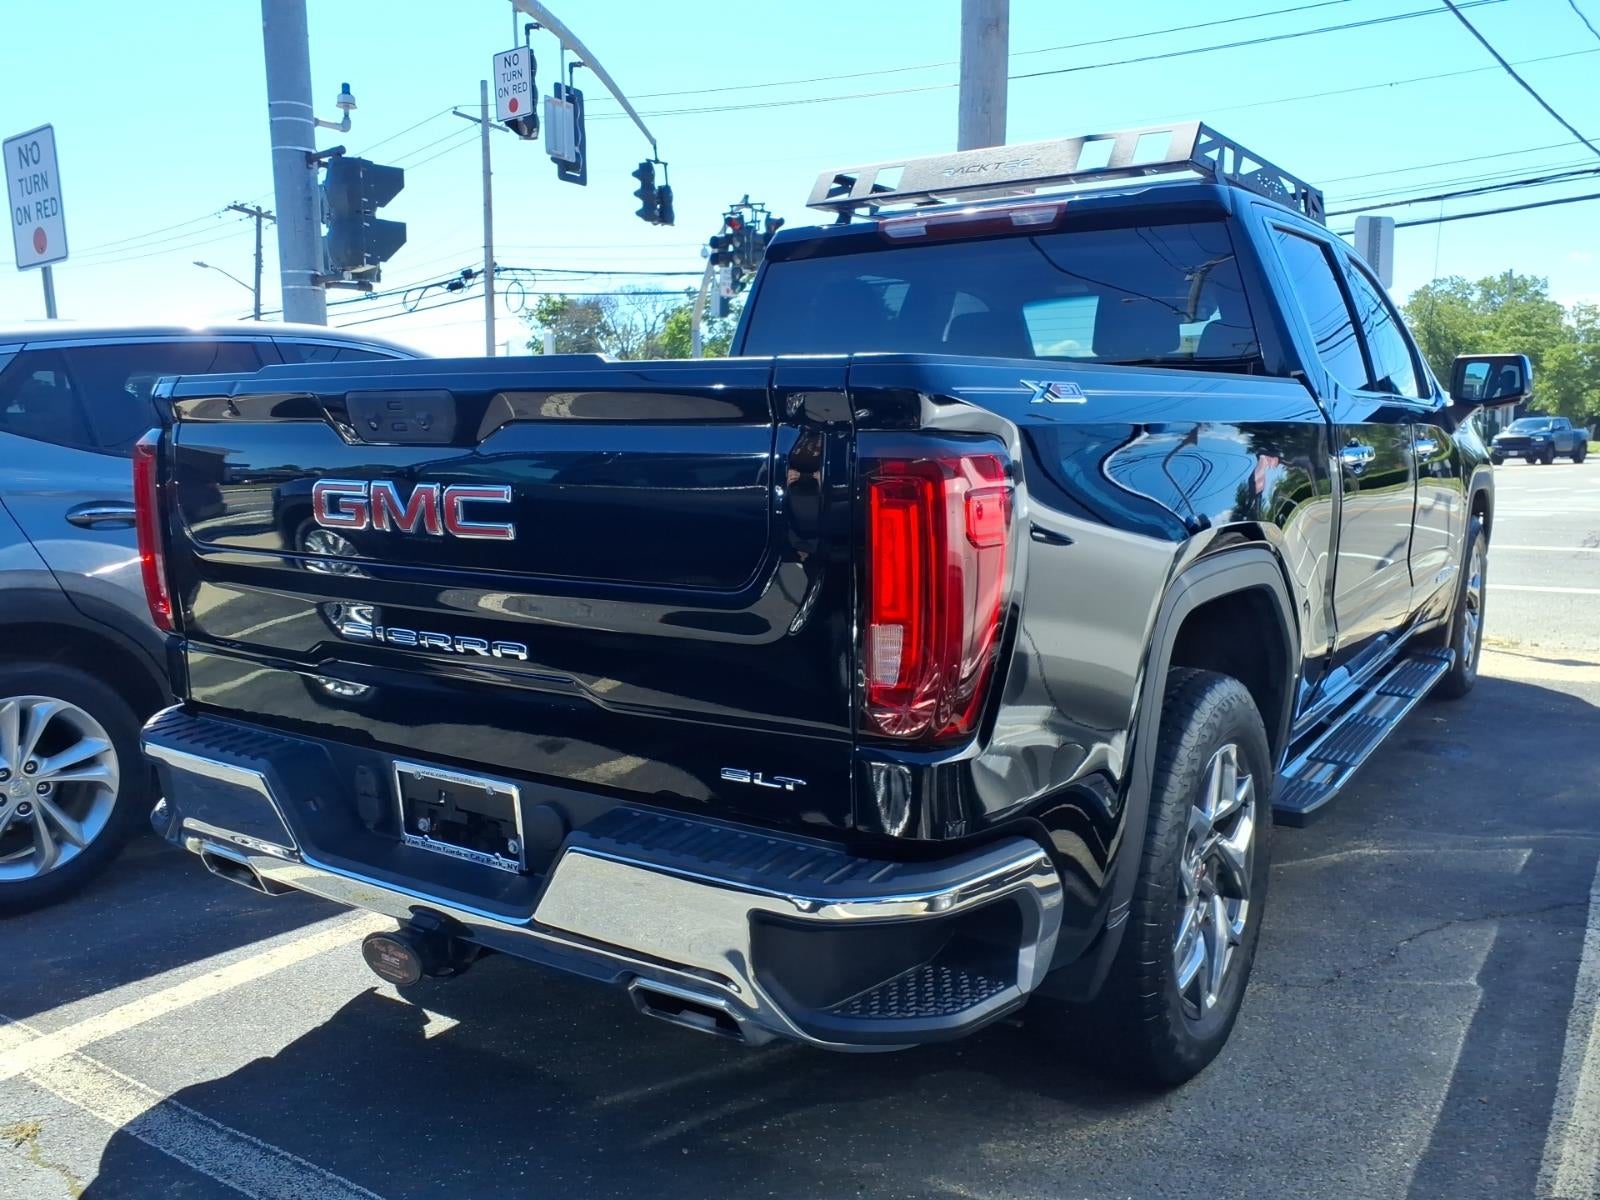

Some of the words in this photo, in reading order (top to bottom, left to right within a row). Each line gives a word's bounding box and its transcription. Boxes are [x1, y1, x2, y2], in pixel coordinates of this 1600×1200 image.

[504, 53, 520, 69] NO
[502, 68, 523, 83] TURN
[498, 87, 509, 98] ON
[513, 81, 528, 95] RED
[18, 141, 41, 169] NO
[18, 171, 49, 198] TURN
[16, 204, 32, 226] ON
[36, 197, 58, 221] RED
[312, 478, 516, 540] GMC
[341, 621, 528, 661] SIERRA
[721, 767, 807, 791] SLT
